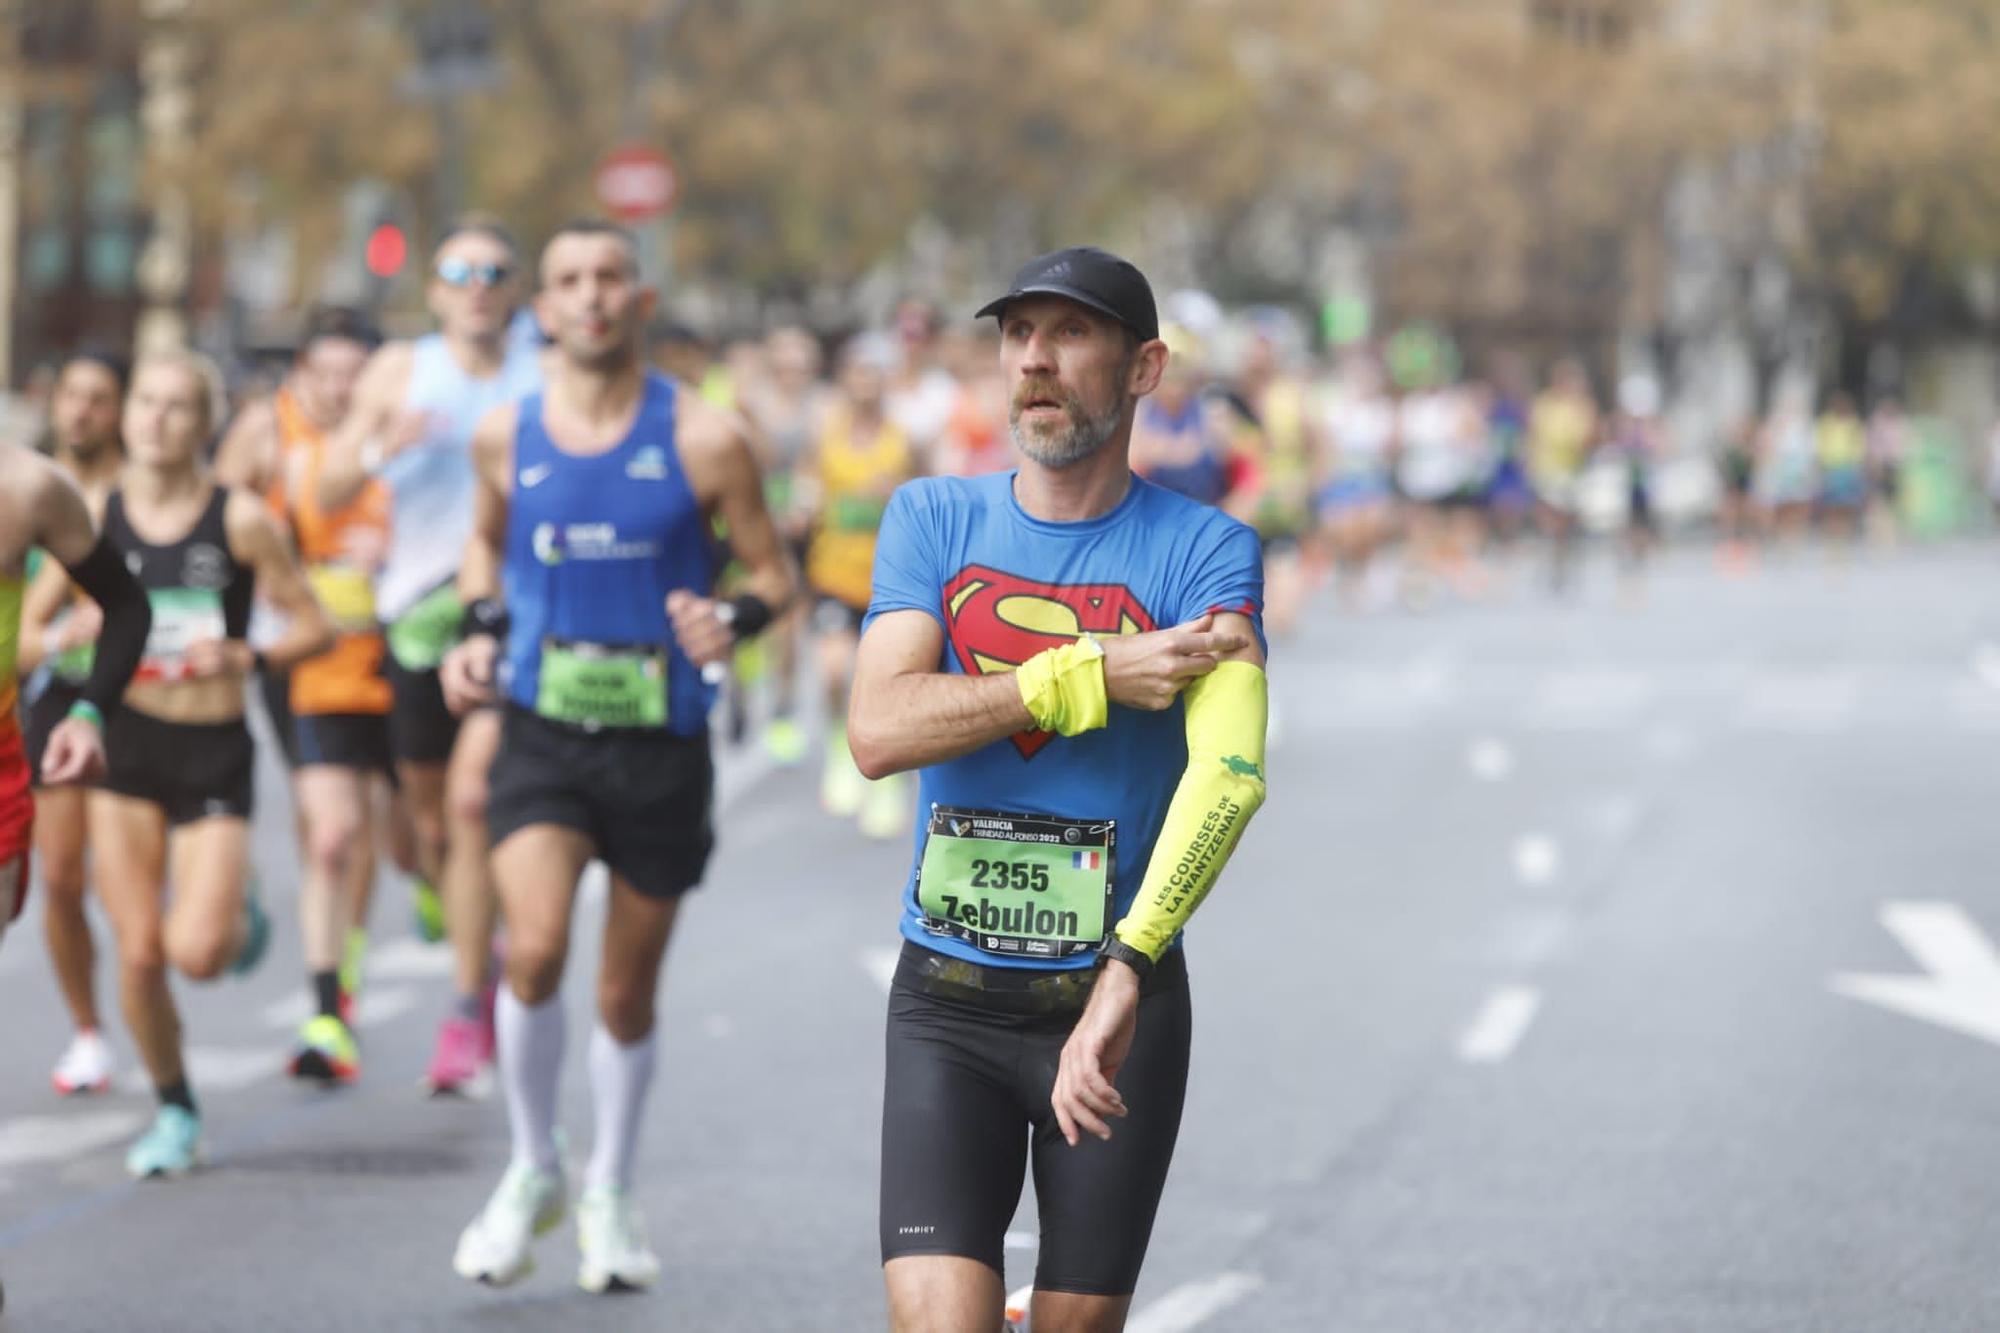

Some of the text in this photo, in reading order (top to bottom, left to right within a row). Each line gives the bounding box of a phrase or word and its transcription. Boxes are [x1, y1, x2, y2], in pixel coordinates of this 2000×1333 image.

[973, 819, 1013, 831] VALENCIA
[973, 829, 1004, 839] TRINIDAD
[1005, 831, 1039, 841] ALFONSO
[1154, 885, 1172, 906] LES
[1170, 811, 1220, 886] COURSES
[1219, 795, 1230, 810] DE
[1166, 894, 1184, 914] LA
[1181, 804, 1240, 897] WANTZENAU
[971, 859, 1050, 892] 2355
[941, 895, 1078, 937] Zebulon
